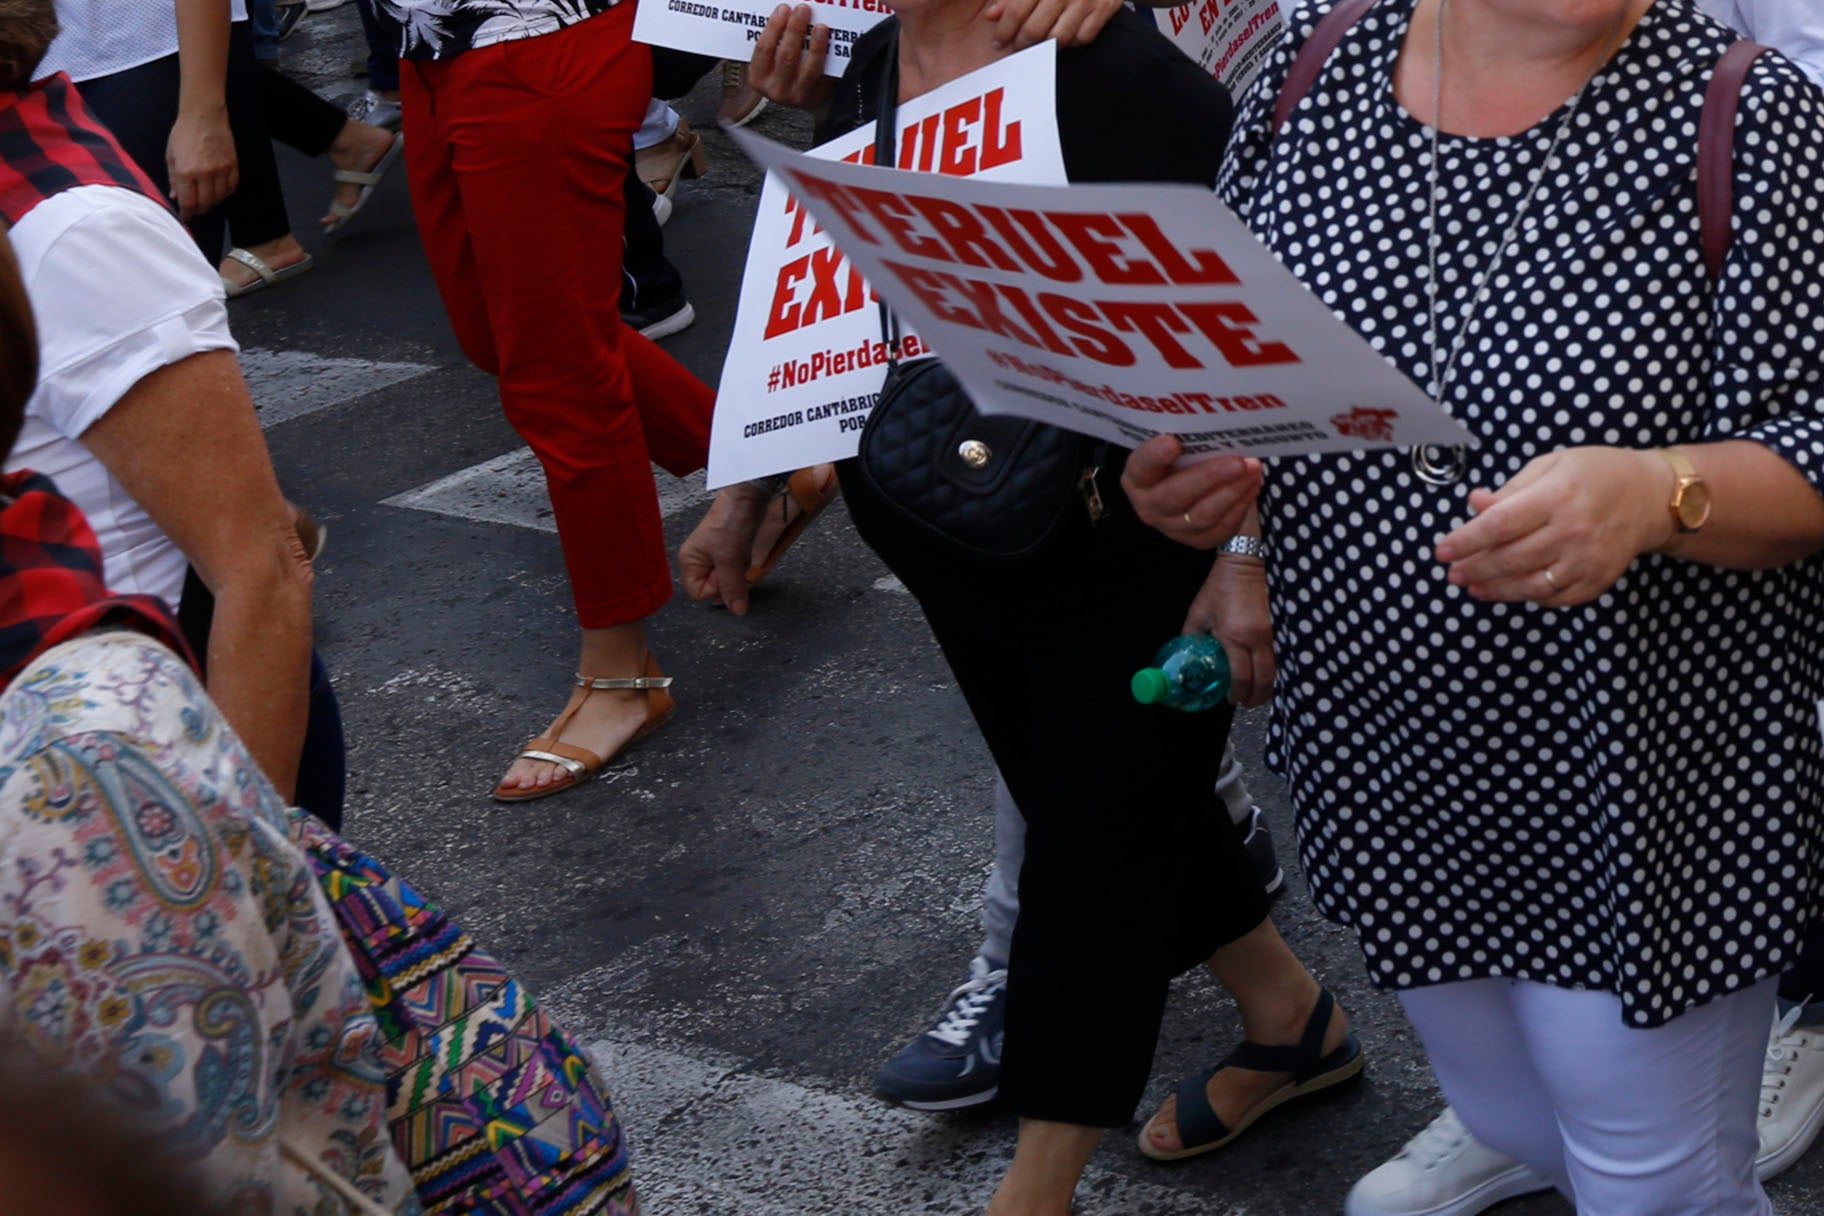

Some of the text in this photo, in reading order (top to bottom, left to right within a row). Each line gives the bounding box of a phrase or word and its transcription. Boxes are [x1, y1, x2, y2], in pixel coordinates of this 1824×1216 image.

[668, 0, 719, 20] CORREDOR
[1214, 1, 1279, 76] PierdaselTren
[791, 168, 1244, 287] TERUEL
[763, 243, 880, 341] EXI
[878, 260, 1303, 370] EXISTE
[744, 411, 803, 439] CORREDOR
[839, 414, 865, 434] POR
